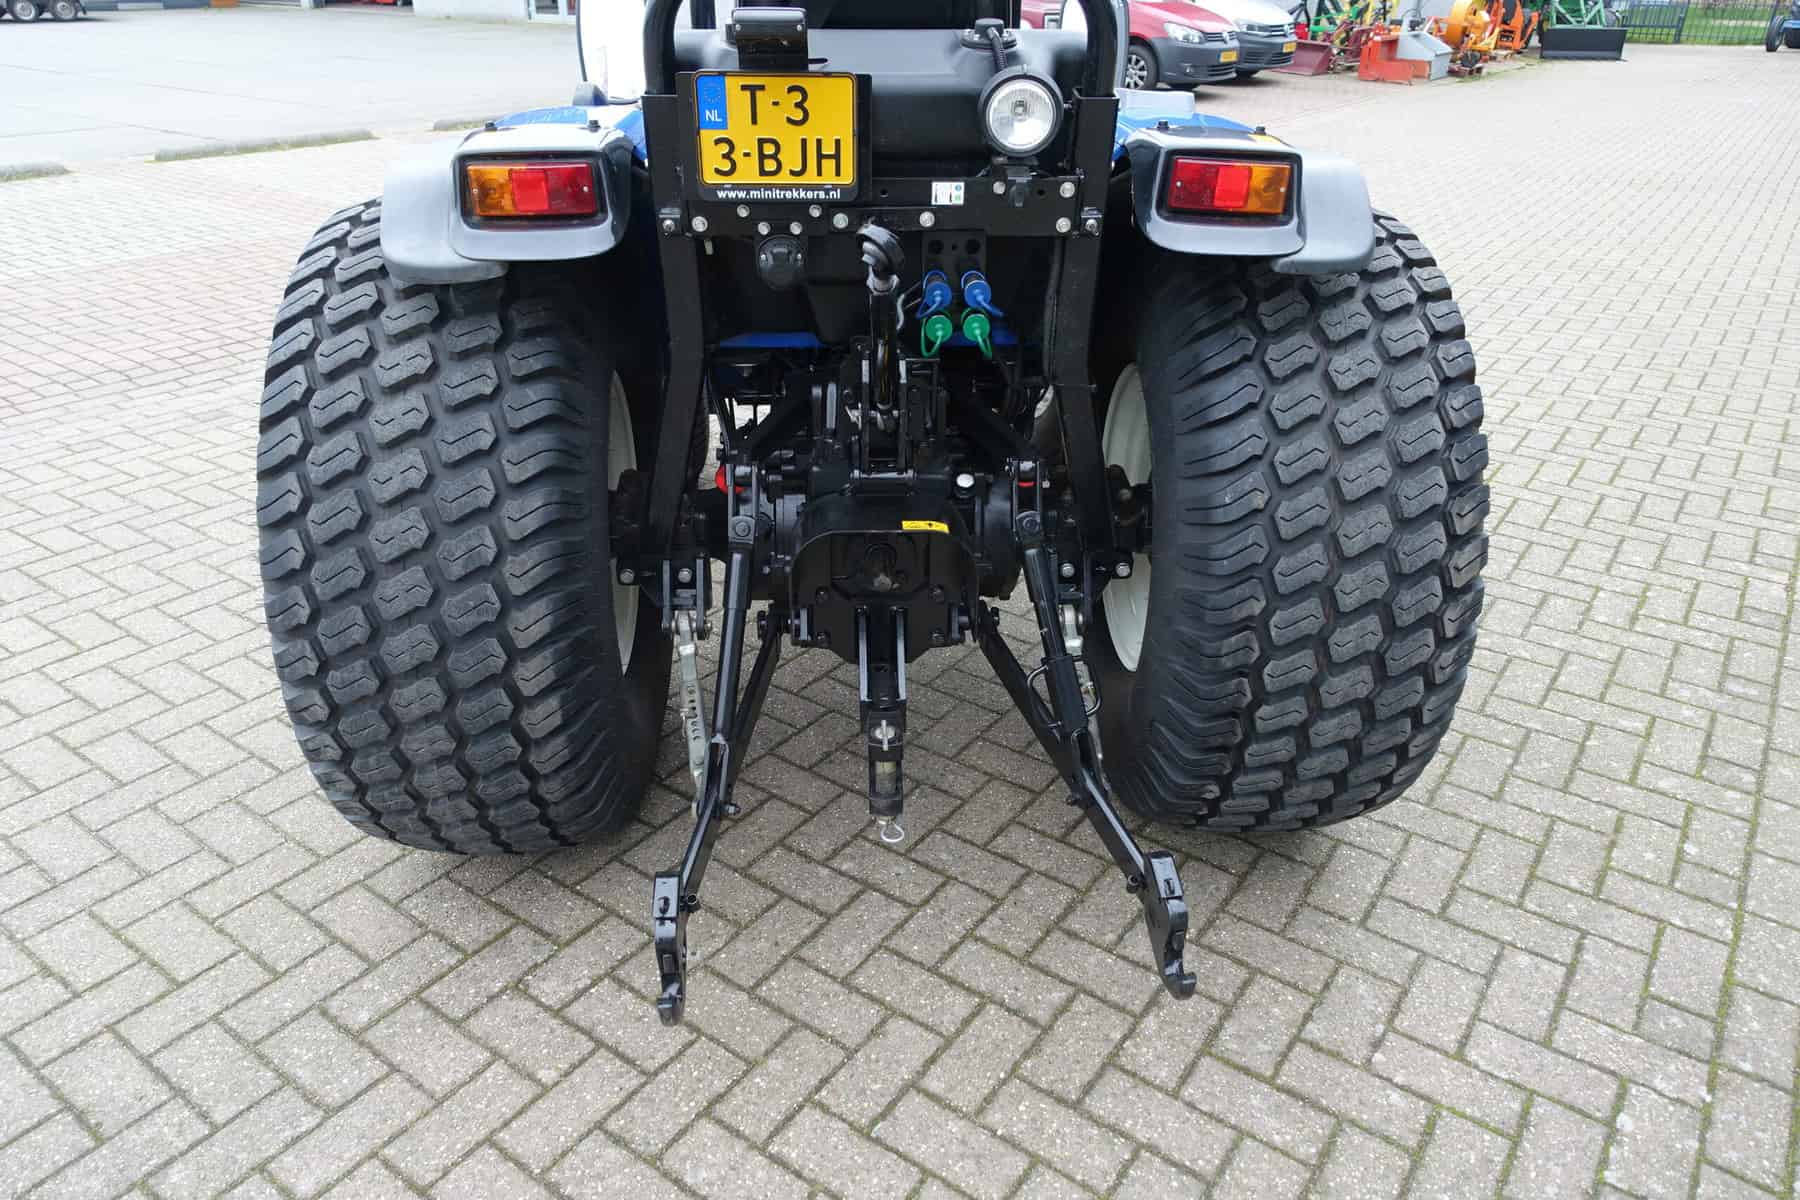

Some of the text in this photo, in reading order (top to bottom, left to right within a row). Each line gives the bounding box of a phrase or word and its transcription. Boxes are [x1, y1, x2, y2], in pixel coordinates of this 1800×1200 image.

[705, 109, 722, 122] NL
[740, 84, 810, 126] T-3
[713, 137, 841, 177] 3-BJH
[716, 188, 841, 200] www.minitrekkers.nl
